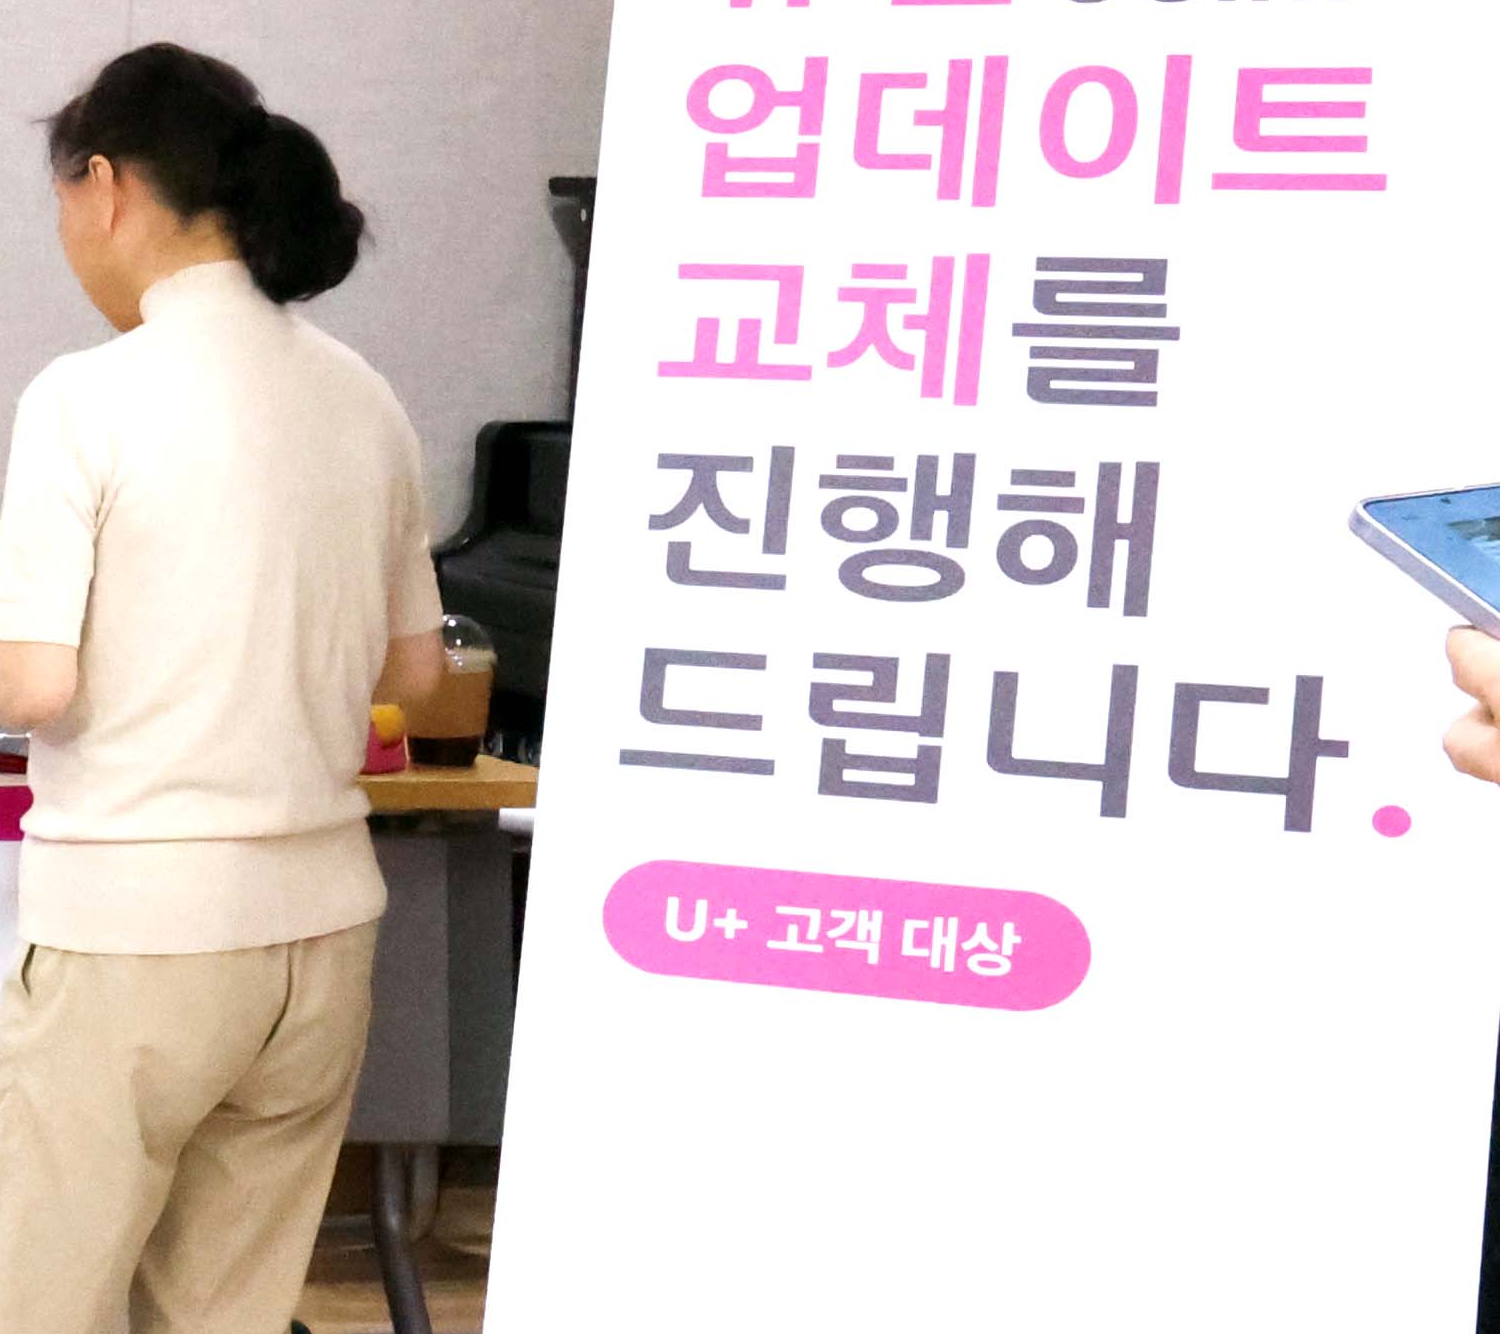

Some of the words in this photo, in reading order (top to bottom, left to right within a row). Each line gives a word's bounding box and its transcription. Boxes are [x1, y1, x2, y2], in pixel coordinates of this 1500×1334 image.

[687, 55, 1386, 207] 업데이트
[658, 254, 1180, 406] 교체를
[649, 446, 1160, 617] 진행해
[620, 648, 1411, 837] 드립니다.
[666, 897, 747, 941] U+
[767, 906, 882, 964] 고객
[902, 917, 1021, 975] 대상
